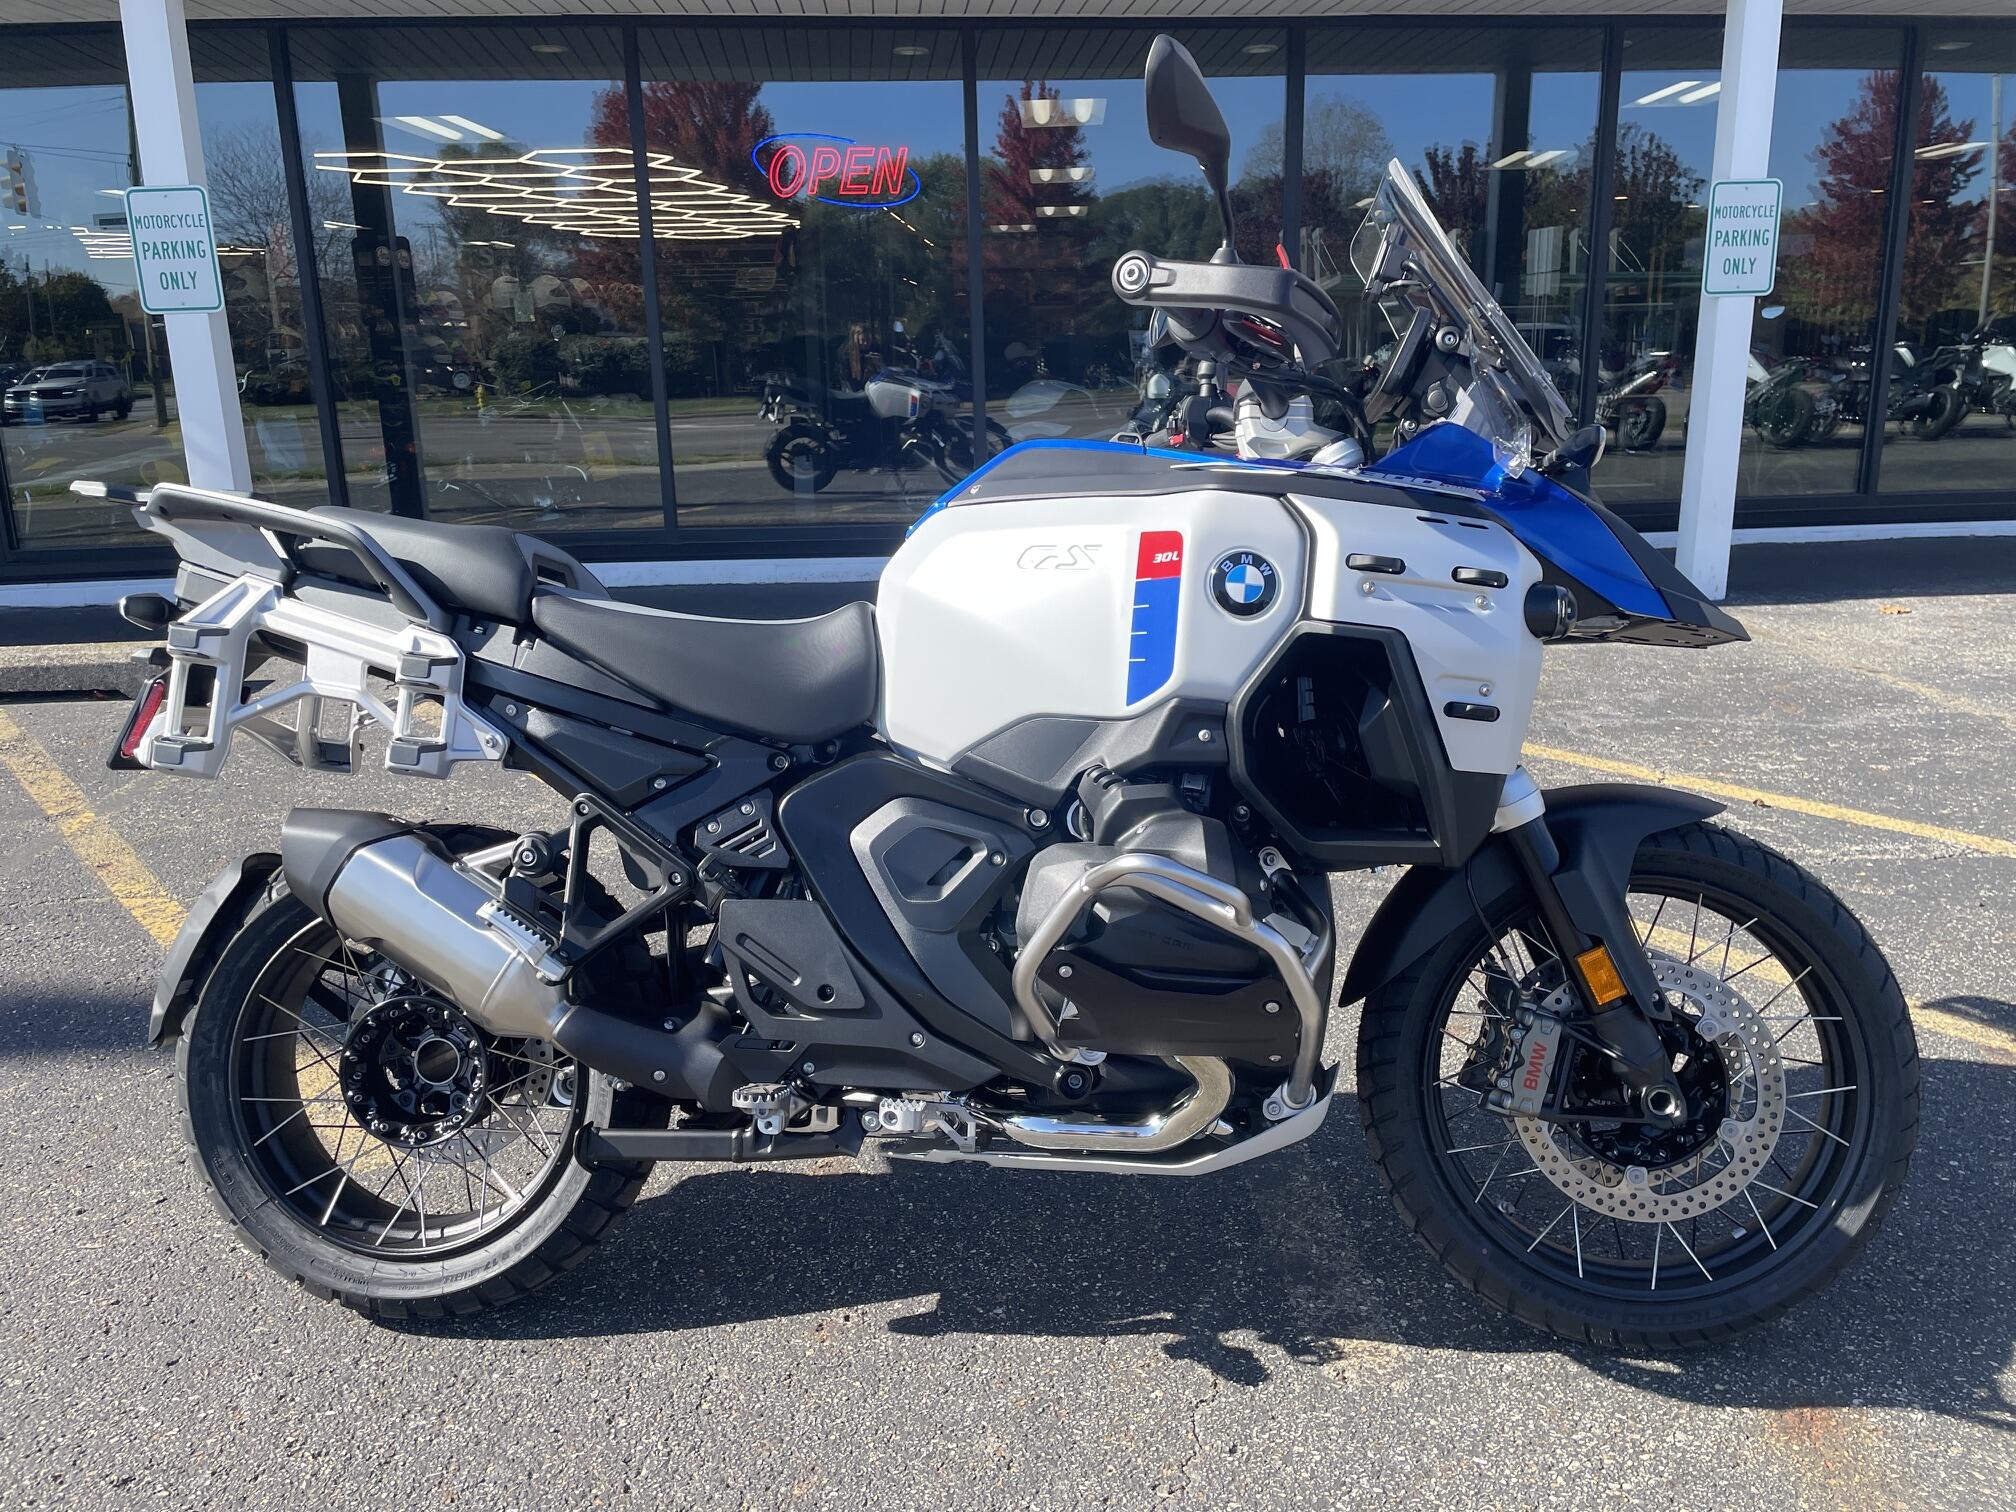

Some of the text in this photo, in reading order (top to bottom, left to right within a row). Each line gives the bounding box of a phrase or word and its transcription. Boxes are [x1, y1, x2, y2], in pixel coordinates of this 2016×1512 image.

[768, 144, 909, 199] OPEN
[134, 213, 205, 230] MOTORCYCLE
[1714, 205, 1776, 219] MOTORCYCLE
[1714, 229, 1770, 247] PARKING
[141, 240, 207, 261] PARKING
[1722, 257, 1757, 275] ONLY
[159, 271, 198, 291] ONLY
[1016, 544, 1103, 571] GS
[1152, 551, 1180, 564] 30L
[1220, 553, 1272, 577] BMW
[1522, 1041, 1548, 1091] BMW
